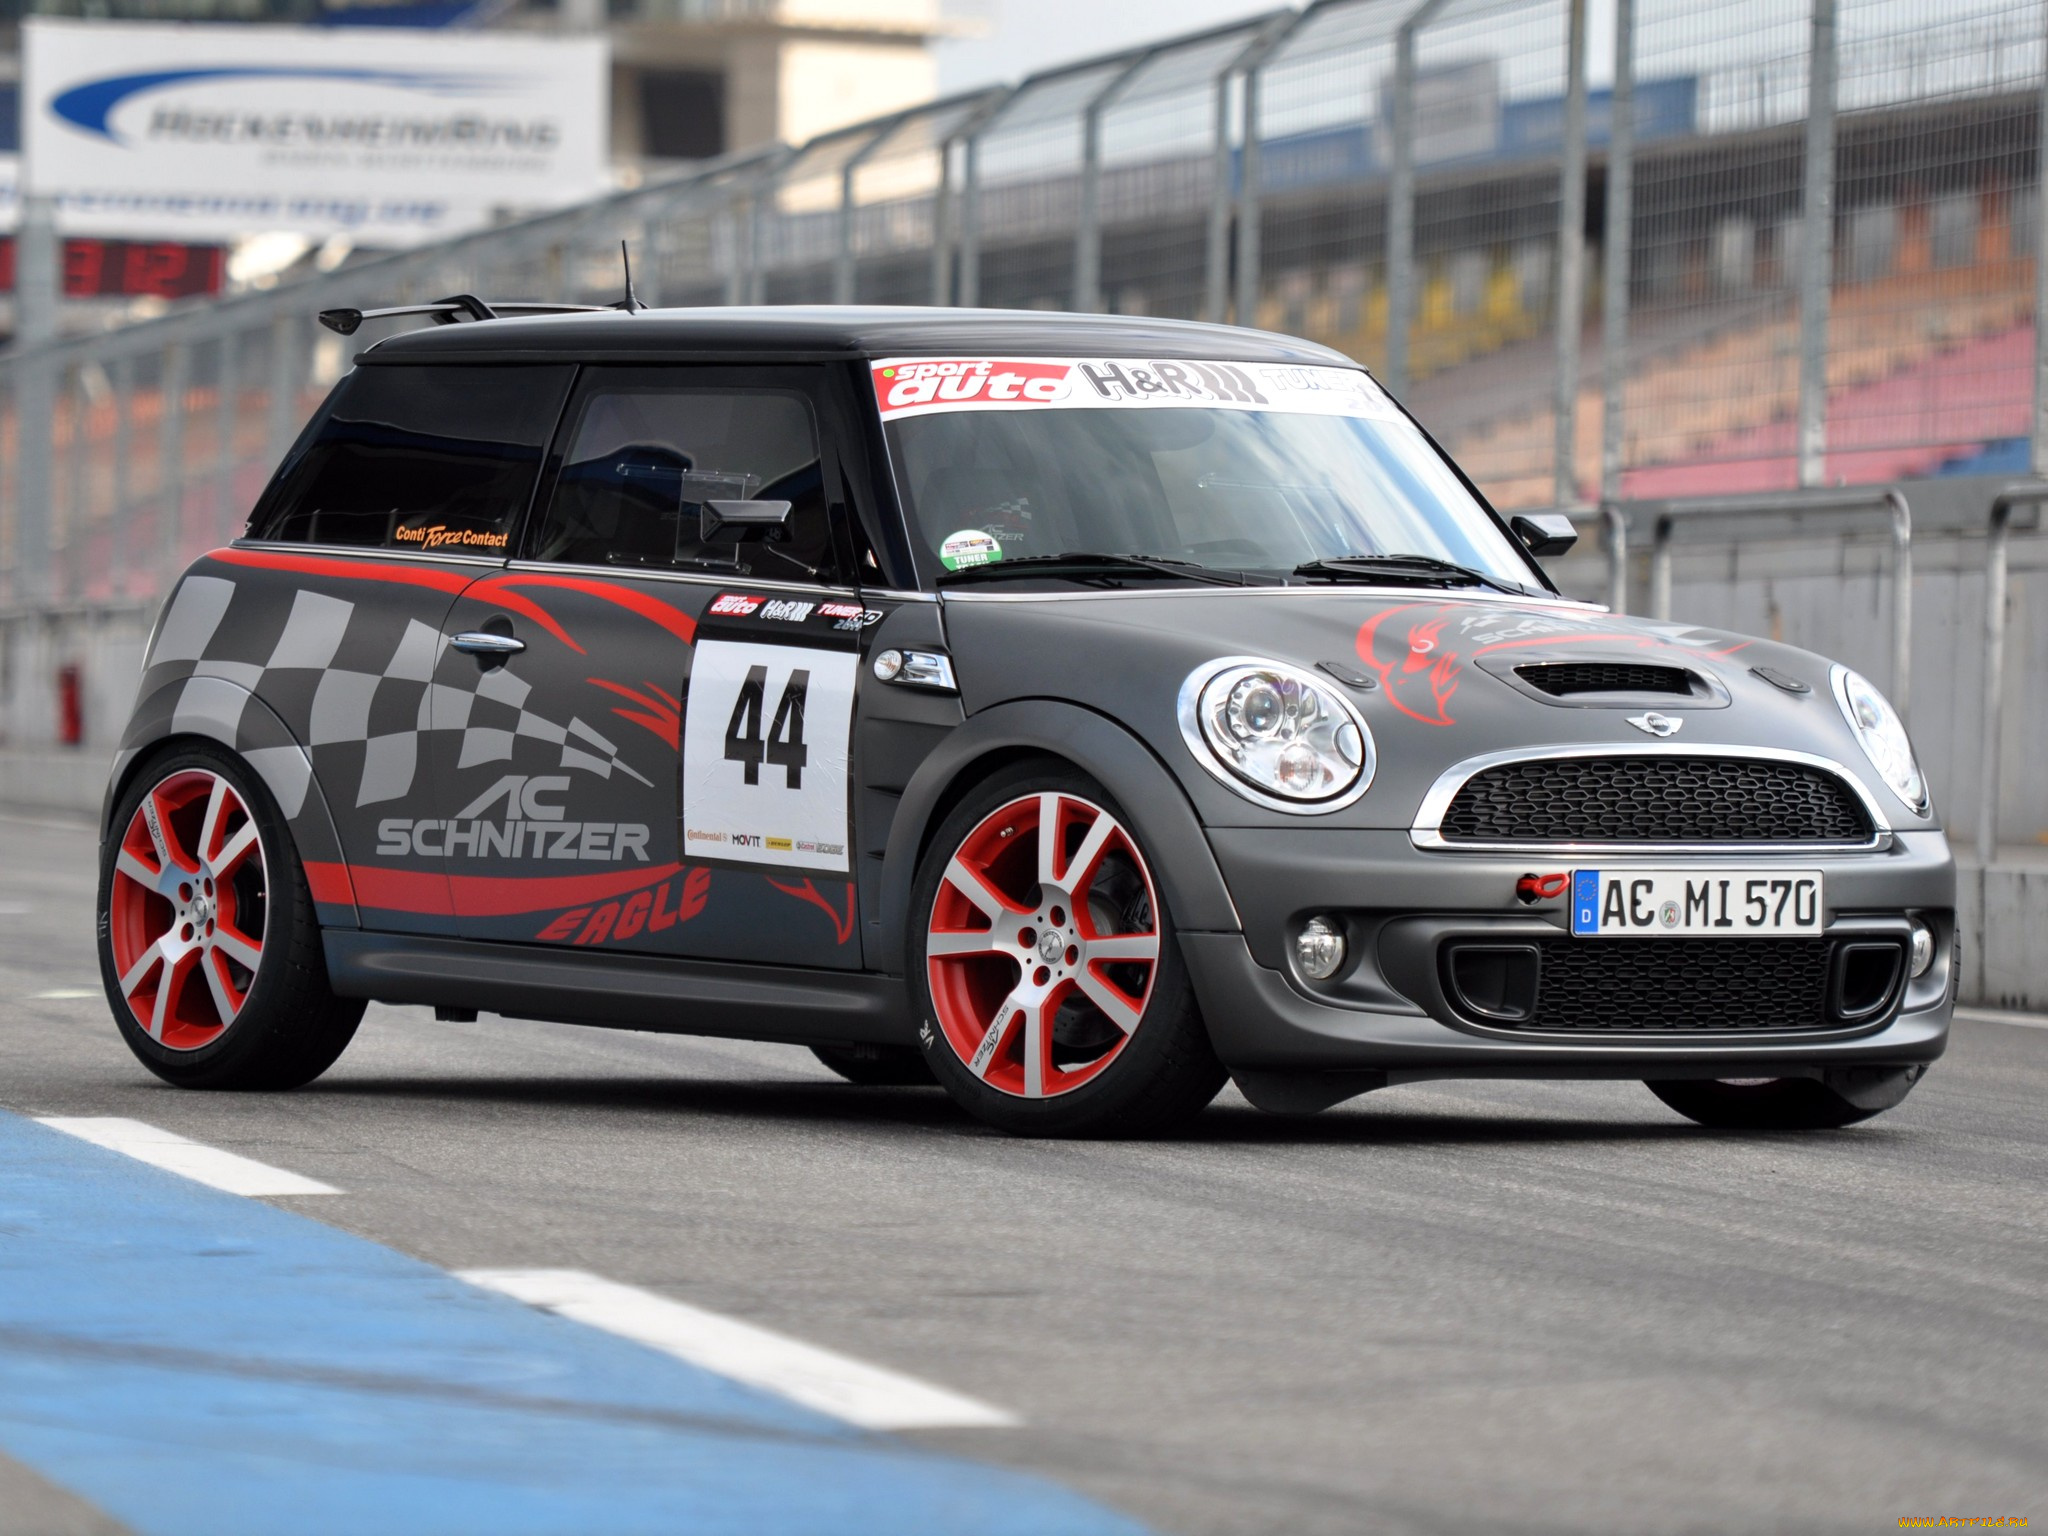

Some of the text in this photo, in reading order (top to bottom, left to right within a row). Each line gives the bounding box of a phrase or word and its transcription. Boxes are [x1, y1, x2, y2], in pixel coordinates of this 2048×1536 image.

[887, 372, 1072, 407] auto
[895, 361, 993, 381] sport
[1079, 361, 1208, 400] H&R
[953, 553, 988, 565] TUNER
[710, 600, 759, 614] auto
[760, 600, 797, 620] H&R
[817, 603, 864, 618] TUNER
[724, 665, 811, 790] 44
[454, 775, 571, 821] AC
[375, 818, 651, 862] SCHNITZER
[535, 867, 712, 945] EAGLE
[1581, 909, 1592, 923] D
[1602, 879, 1816, 927] AC MI 570
[974, 1004, 1010, 1068] SCHNITZER
